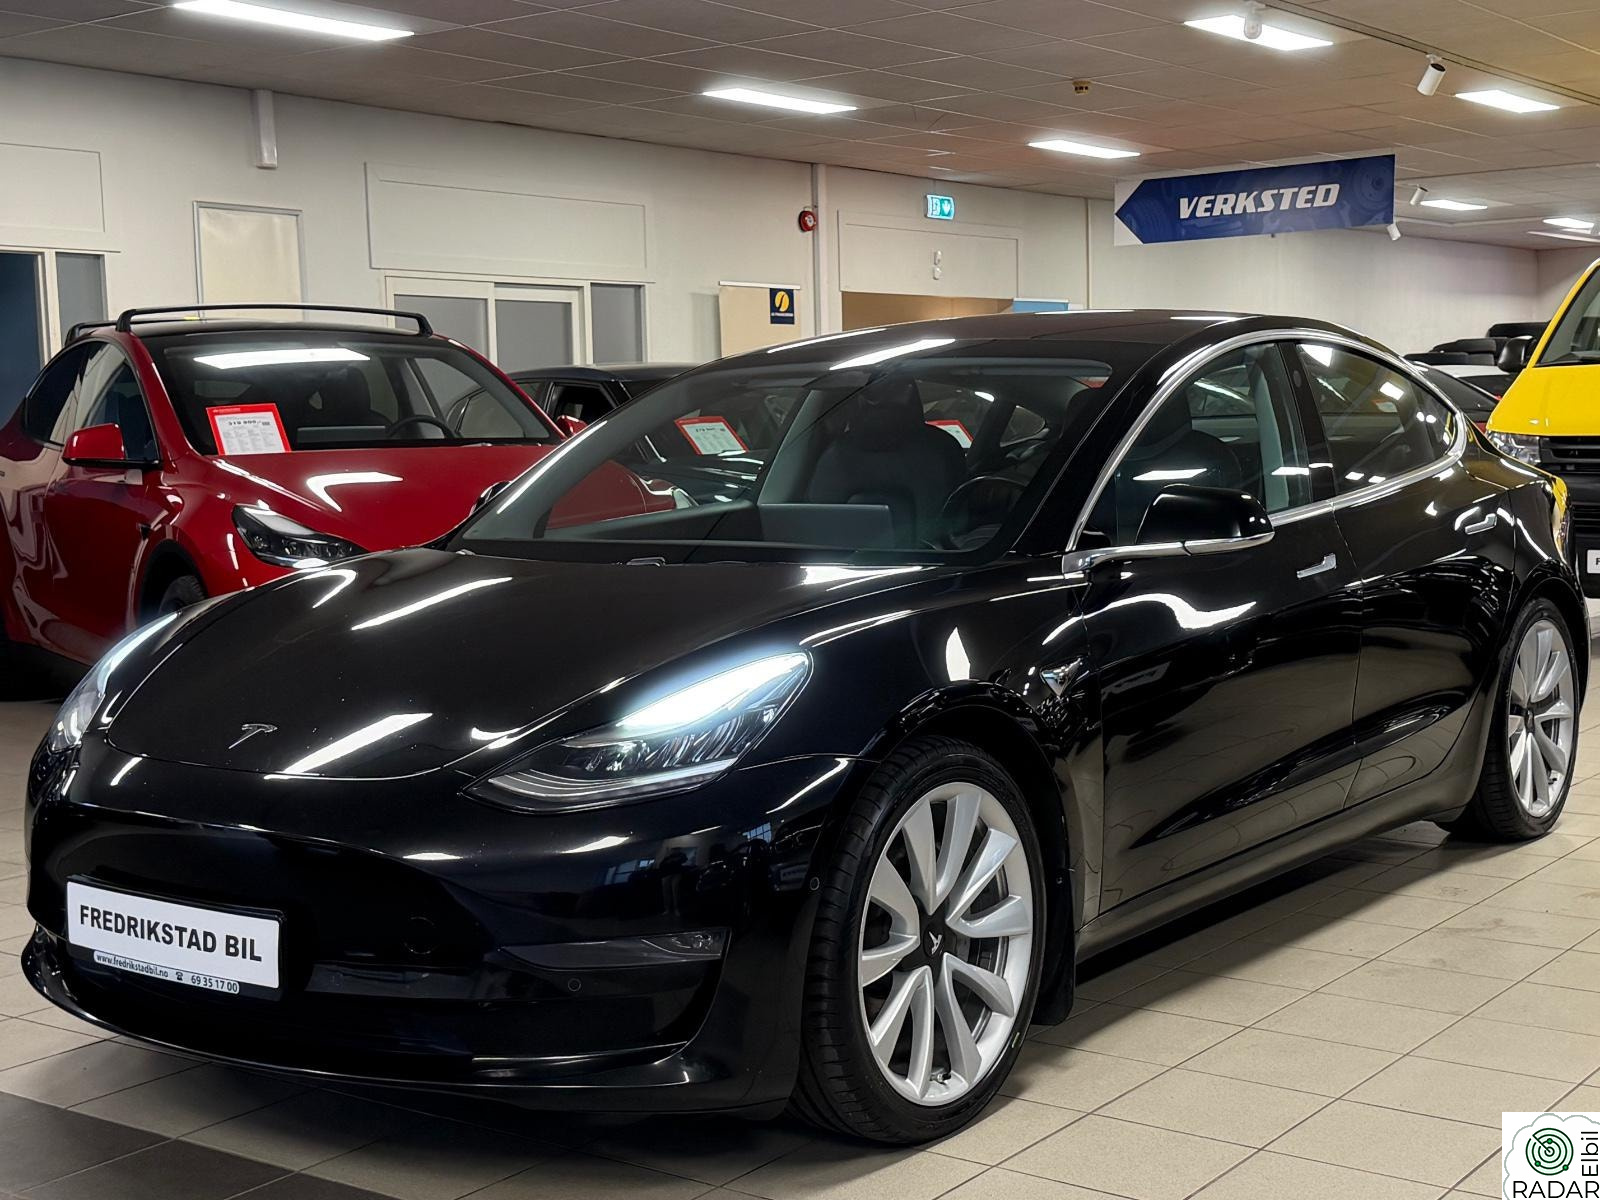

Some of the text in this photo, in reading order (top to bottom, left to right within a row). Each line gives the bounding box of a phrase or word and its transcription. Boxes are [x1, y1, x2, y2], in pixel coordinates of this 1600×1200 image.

[1178, 183, 1340, 220] VERKSTED
[80, 904, 263, 962] FREDRIKSTAD BIL
[96, 953, 238, 993] www.fredrikstadbil.no 69 35 17 00
